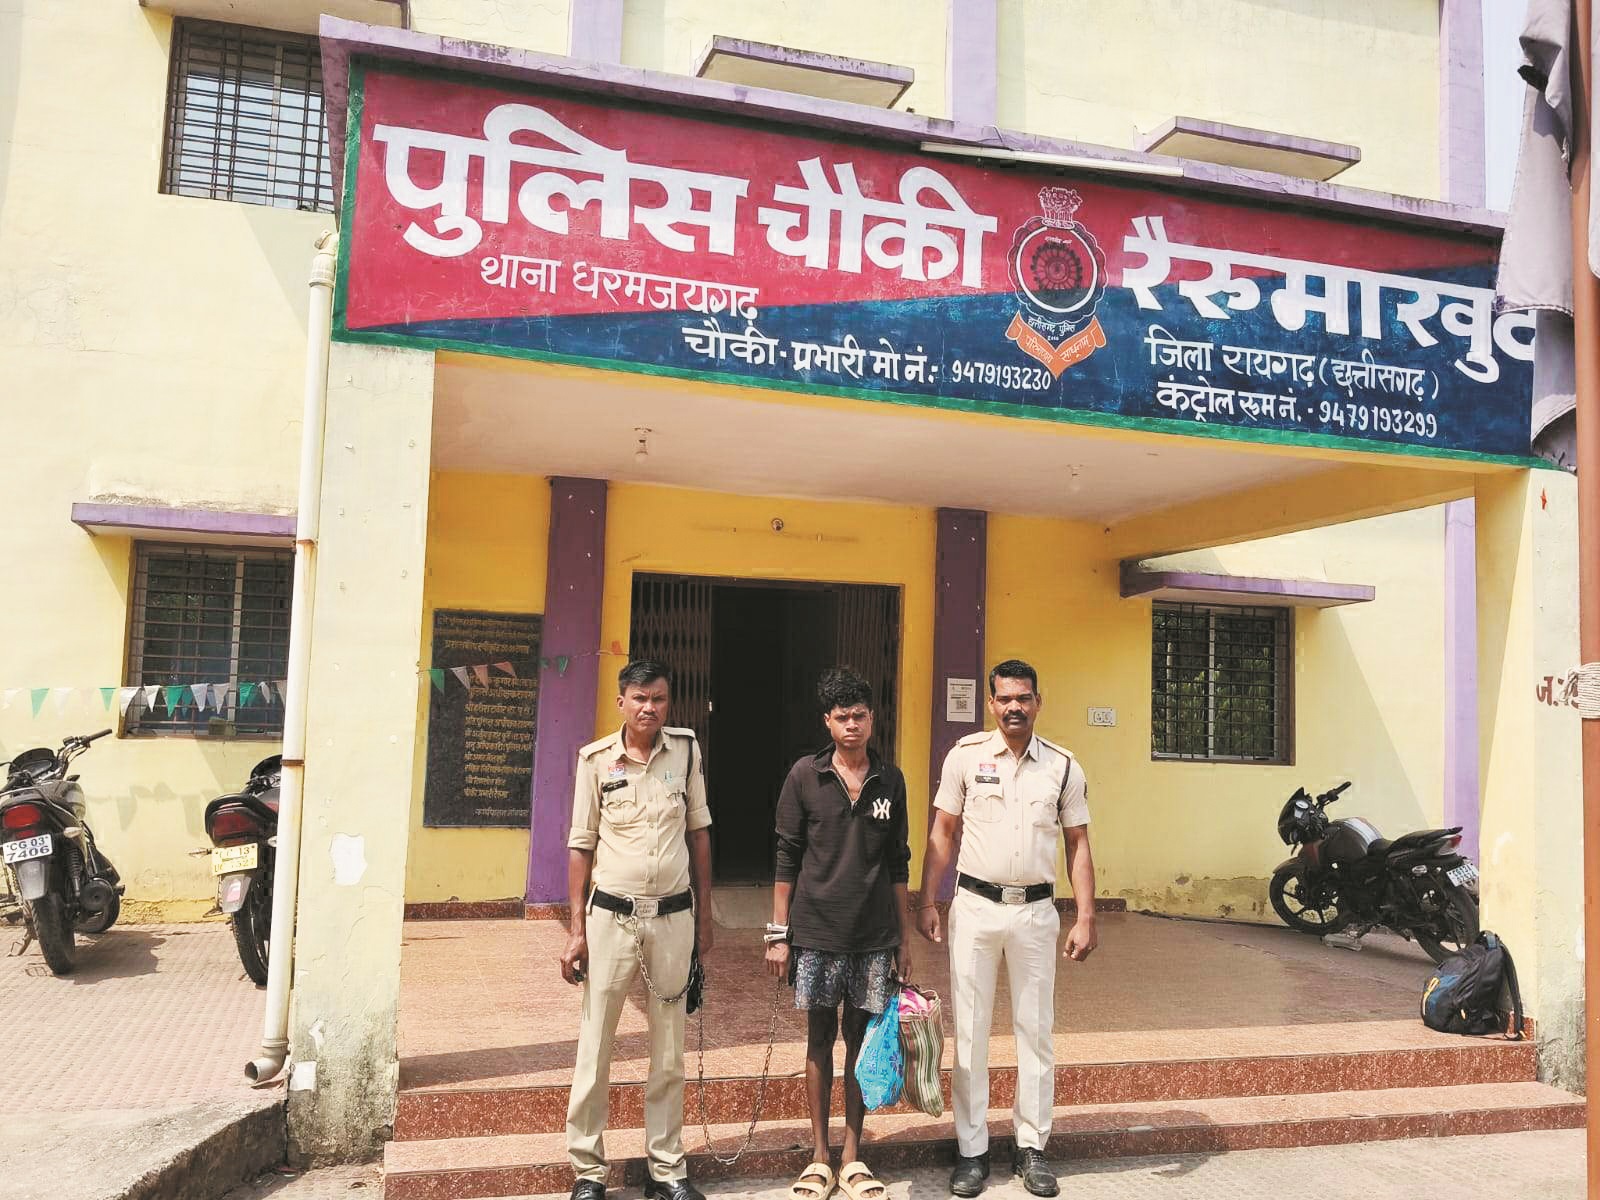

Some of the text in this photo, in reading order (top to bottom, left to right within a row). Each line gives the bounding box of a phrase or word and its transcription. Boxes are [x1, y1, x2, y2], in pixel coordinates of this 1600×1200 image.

[373, 103, 750, 257] पुलिस
[758, 156, 998, 288] चौकी
[480, 254, 759, 326] थाना धरमजयगढ़
[791, 334, 866, 379] प्रभारी
[951, 359, 1051, 391] 9479193230
[1144, 324, 1213, 372] जिला
[1222, 345, 1316, 388] रायगढ़
[1155, 374, 1235, 422] कंट्रोल
[1238, 390, 1275, 422] रूम
[1318, 400, 1438, 439] 9479193299
[6, 845, 51, 862] 7406
[9, 837, 46, 852] CG 03
[238, 846, 250, 856] 13
